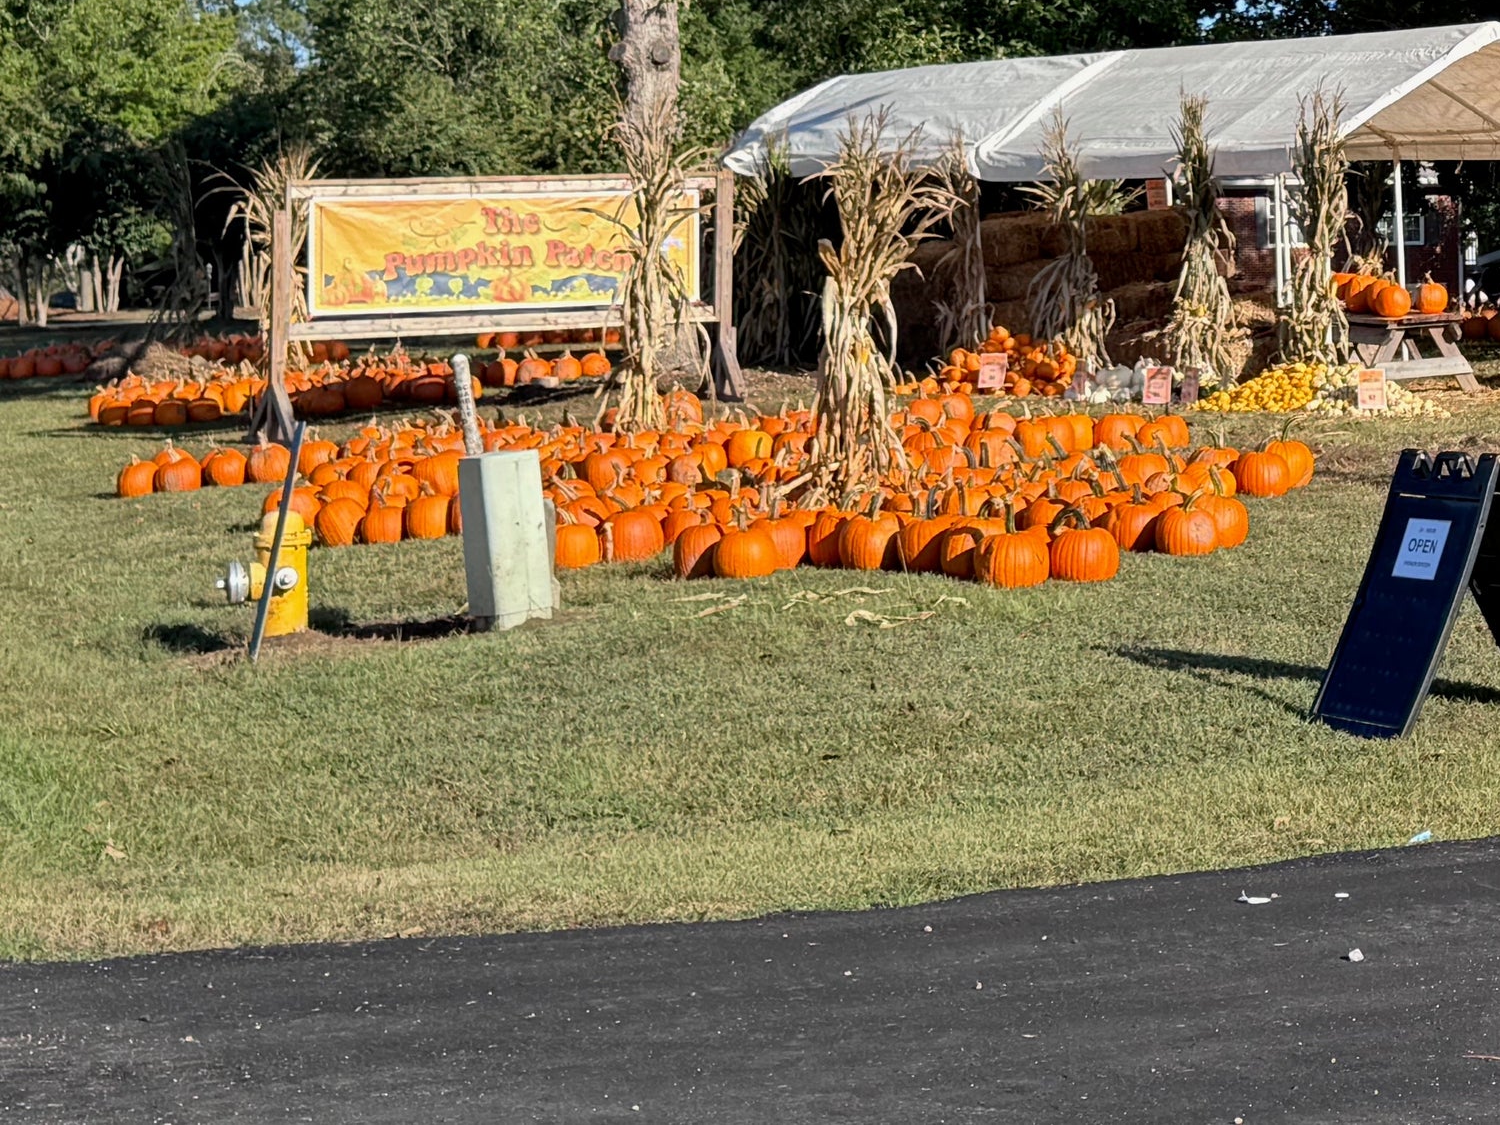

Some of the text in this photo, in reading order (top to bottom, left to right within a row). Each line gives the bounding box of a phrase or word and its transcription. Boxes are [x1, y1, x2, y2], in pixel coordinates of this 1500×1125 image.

[481, 206, 540, 235] The
[383, 241, 534, 281] Pumpkin
[462, 383, 472, 418] CABLE
[1408, 538, 1438, 554] OPEN
